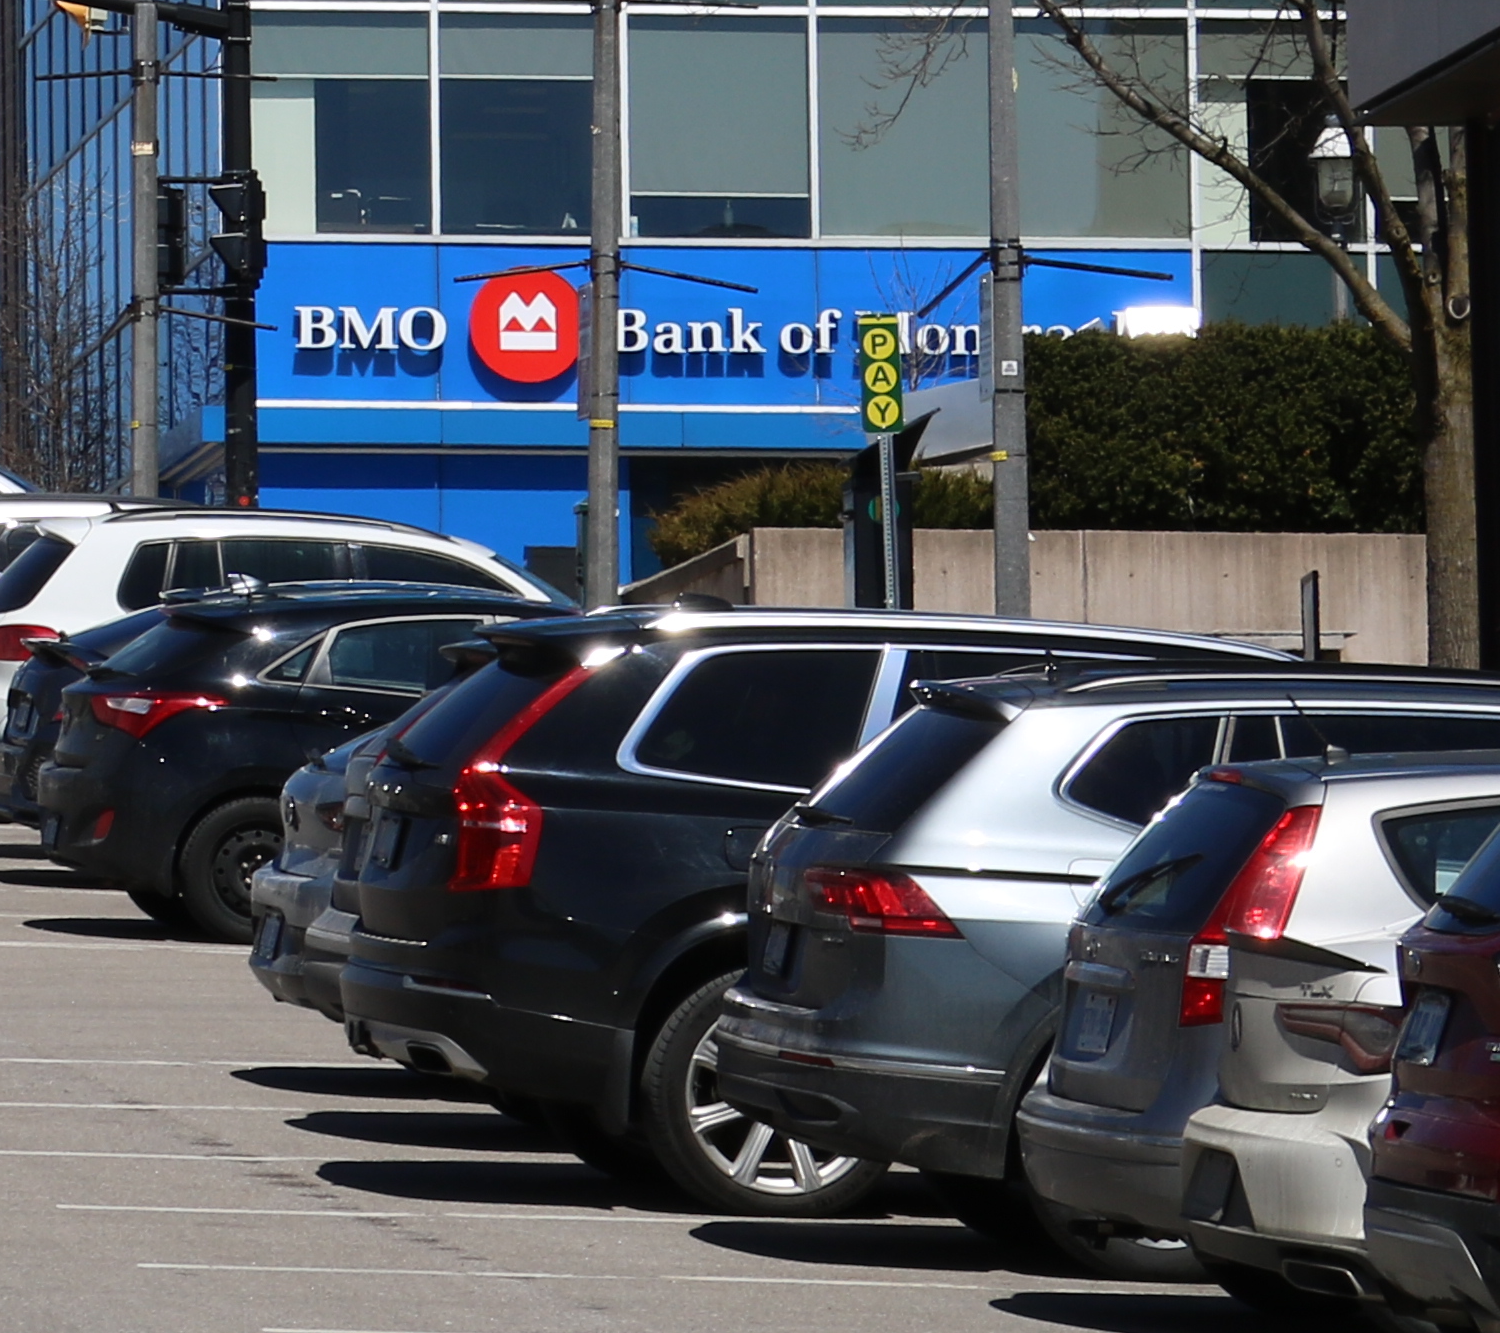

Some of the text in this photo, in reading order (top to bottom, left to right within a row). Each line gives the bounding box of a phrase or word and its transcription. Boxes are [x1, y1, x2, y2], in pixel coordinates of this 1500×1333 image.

[294, 305, 448, 351] BMO
[617, 308, 767, 356] Bank
[781, 309, 842, 355] of
[870, 333, 892, 423] PAY
